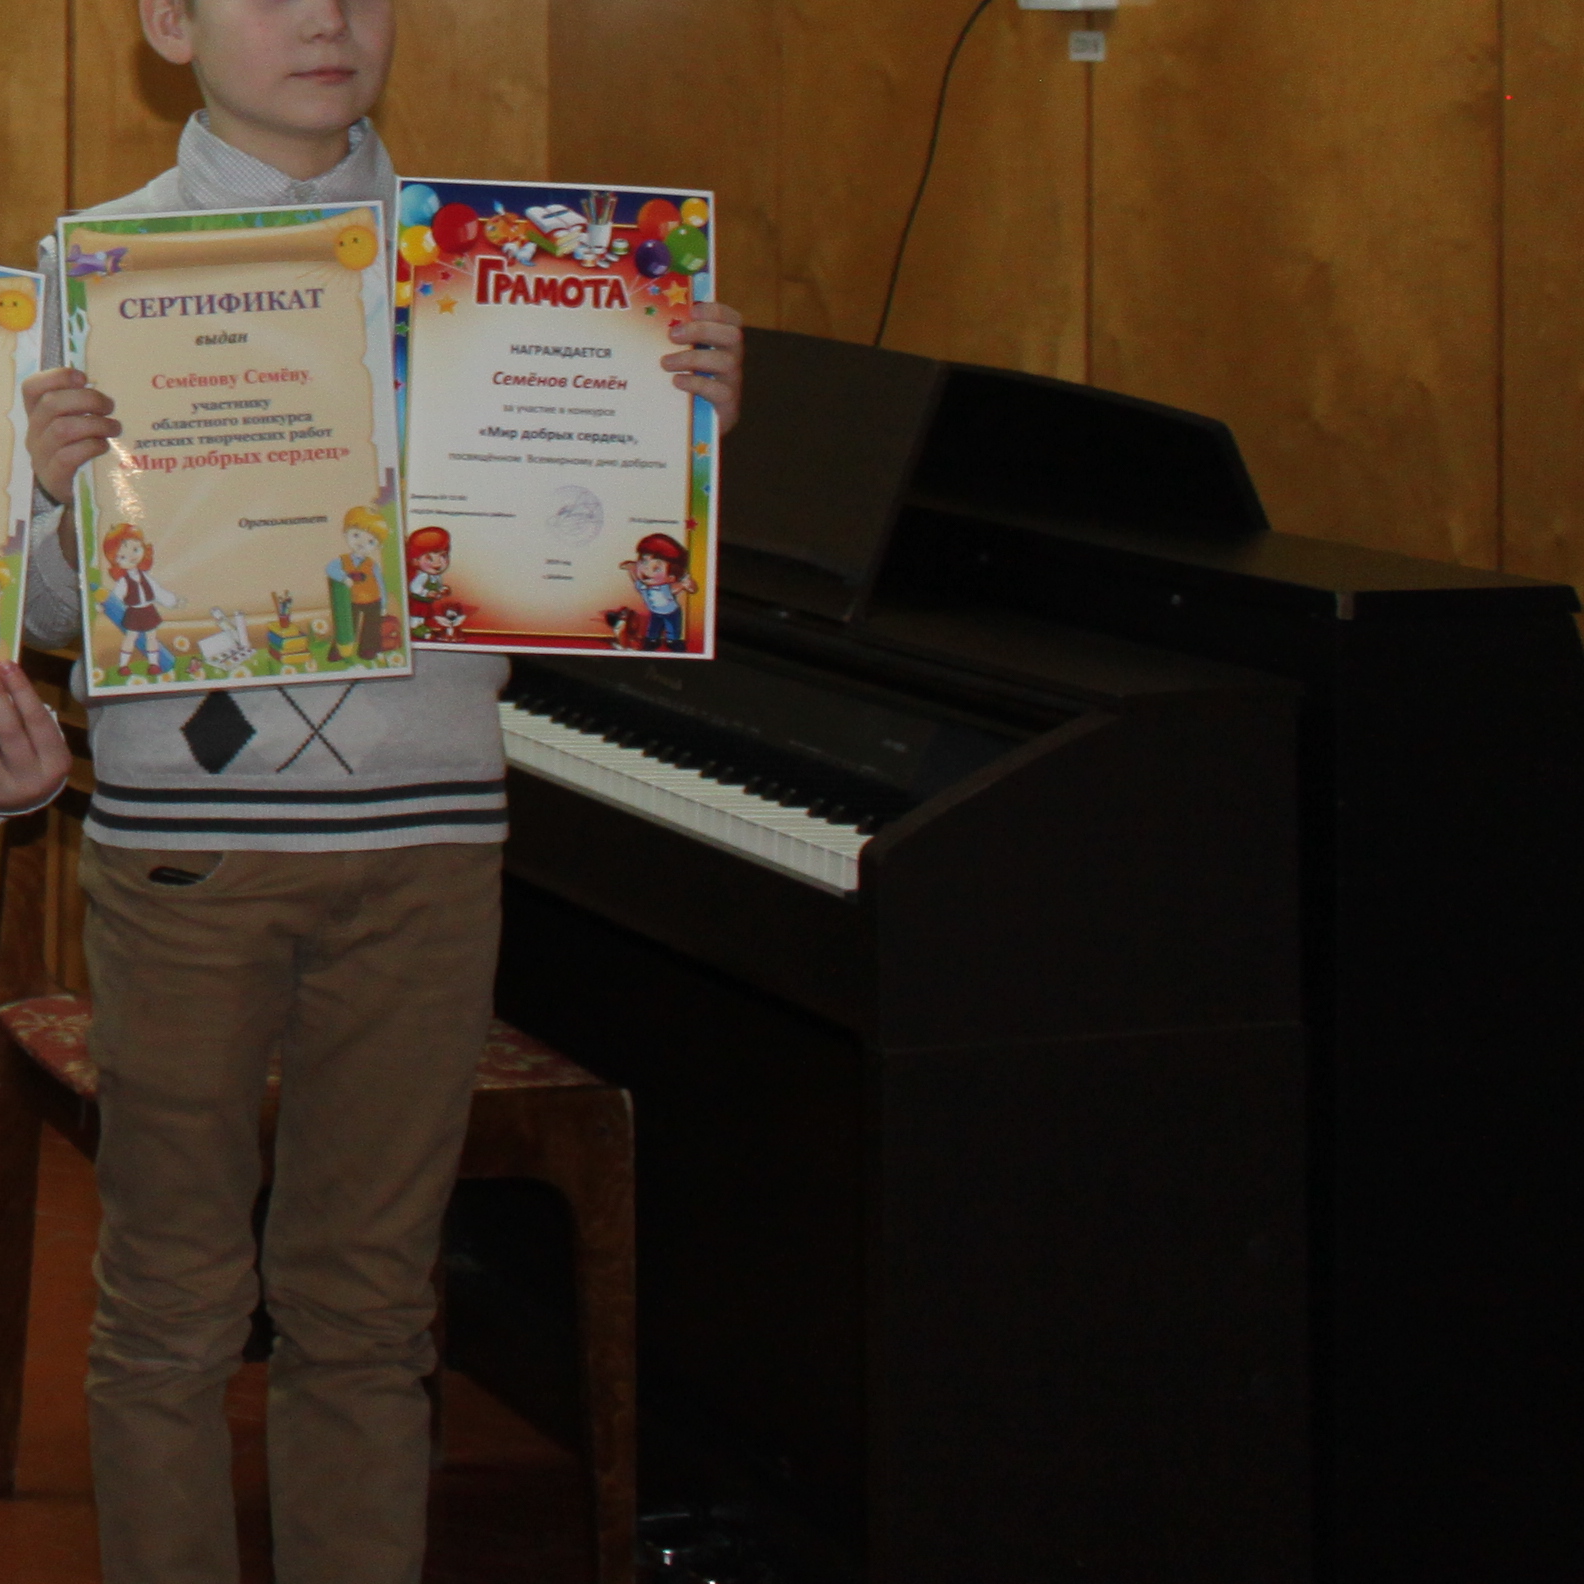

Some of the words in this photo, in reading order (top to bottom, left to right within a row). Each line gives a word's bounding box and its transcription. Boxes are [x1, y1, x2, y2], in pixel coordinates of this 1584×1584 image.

[475, 256, 630, 310] ГРАМОТА
[119, 288, 324, 320] СЕРТИФИКАТ
[196, 332, 248, 346] выдан
[510, 344, 611, 358] НАГРАЖДАЕТСЯ
[151, 373, 238, 391] Семёнову
[492, 371, 567, 388] Семёнов
[573, 374, 628, 390] Семён
[192, 398, 271, 414] участнику
[517, 406, 556, 416] участие
[568, 407, 615, 418] конкурсе
[152, 416, 238, 432] областного
[243, 412, 313, 426] конкурса
[134, 437, 193, 450] детских
[199, 432, 285, 446] творческих
[290, 427, 332, 440] работ
[480, 426, 517, 440] «Мир
[521, 428, 573, 442] добрых
[182, 450, 261, 470] добрых
[268, 447, 350, 463] сердец»
[239, 515, 328, 530] Оргкомитет
